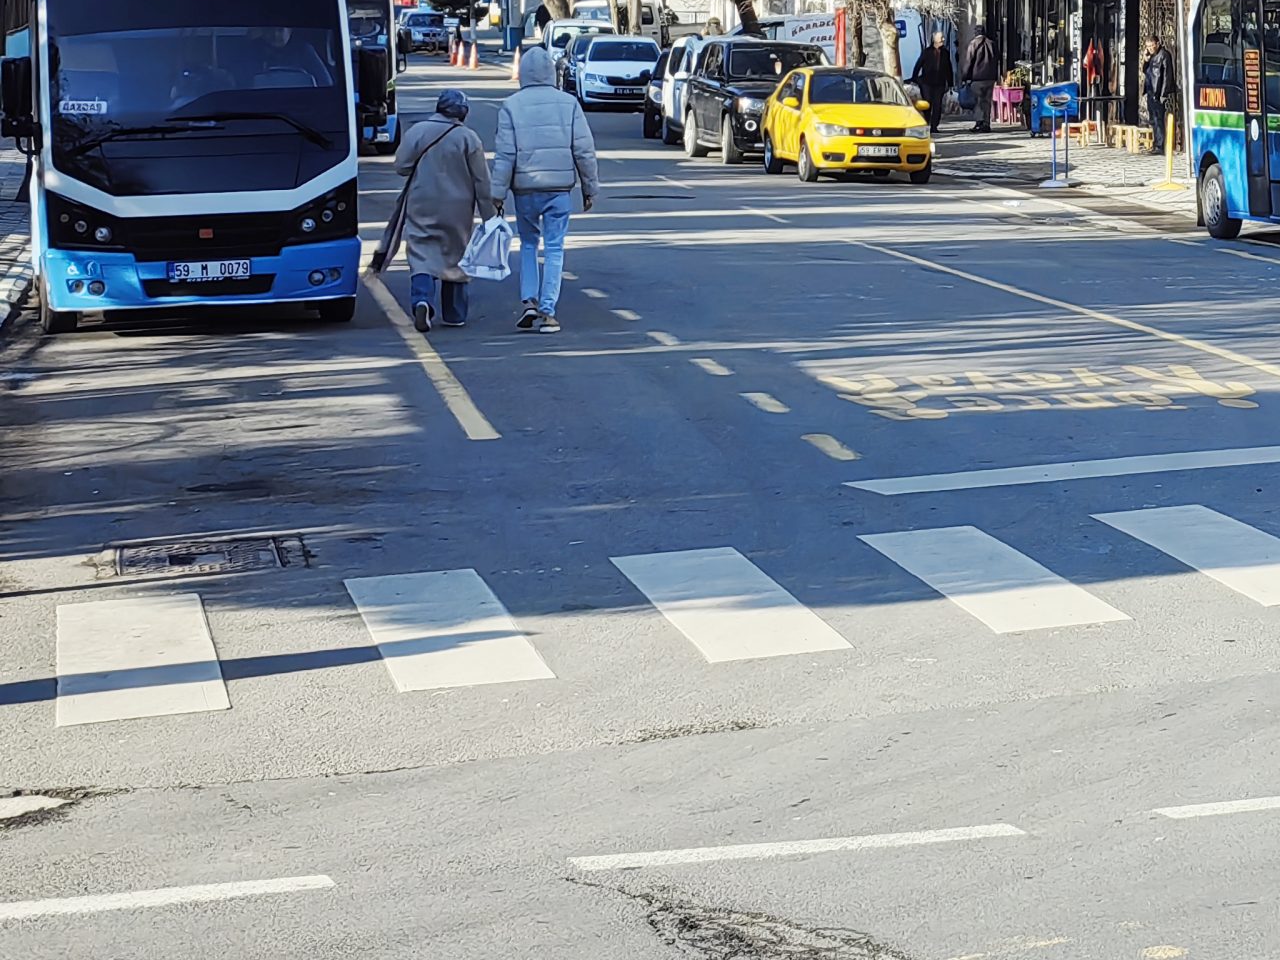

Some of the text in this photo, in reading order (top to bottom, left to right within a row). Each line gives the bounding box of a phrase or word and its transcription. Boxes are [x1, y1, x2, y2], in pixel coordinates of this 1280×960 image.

[1200, 88, 1226, 107] ALTINOVA
[175, 262, 249, 277] 59 M 0079
